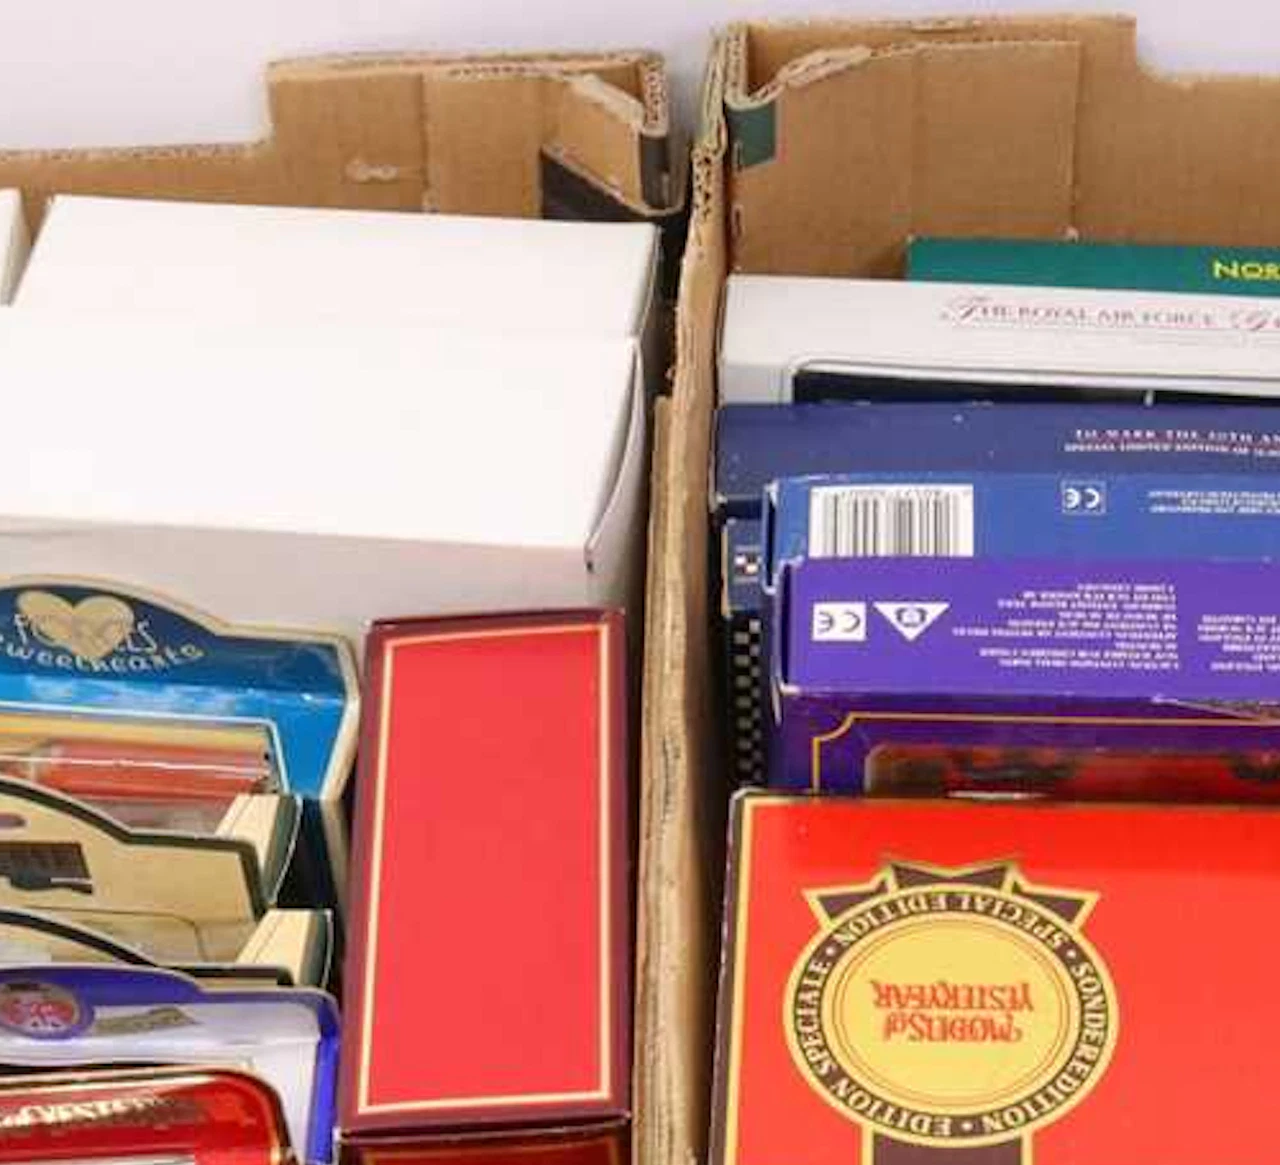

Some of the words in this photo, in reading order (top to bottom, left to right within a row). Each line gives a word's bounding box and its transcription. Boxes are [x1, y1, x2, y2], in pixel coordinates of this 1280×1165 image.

[1018, 305, 1087, 322] ROYAL
[1097, 308, 1134, 323] AIR
[1141, 309, 1213, 326] FORCE
[832, 893, 947, 947] EDITION
[954, 892, 1069, 950] SPECIAL
[869, 979, 1035, 1011] YESTERYEAR
[883, 1011, 909, 1042] of
[909, 1012, 1021, 1044] MODELS
[981, 961, 1107, 1135] SONDEREDITION
[831, 1074, 953, 1137] EDITION
